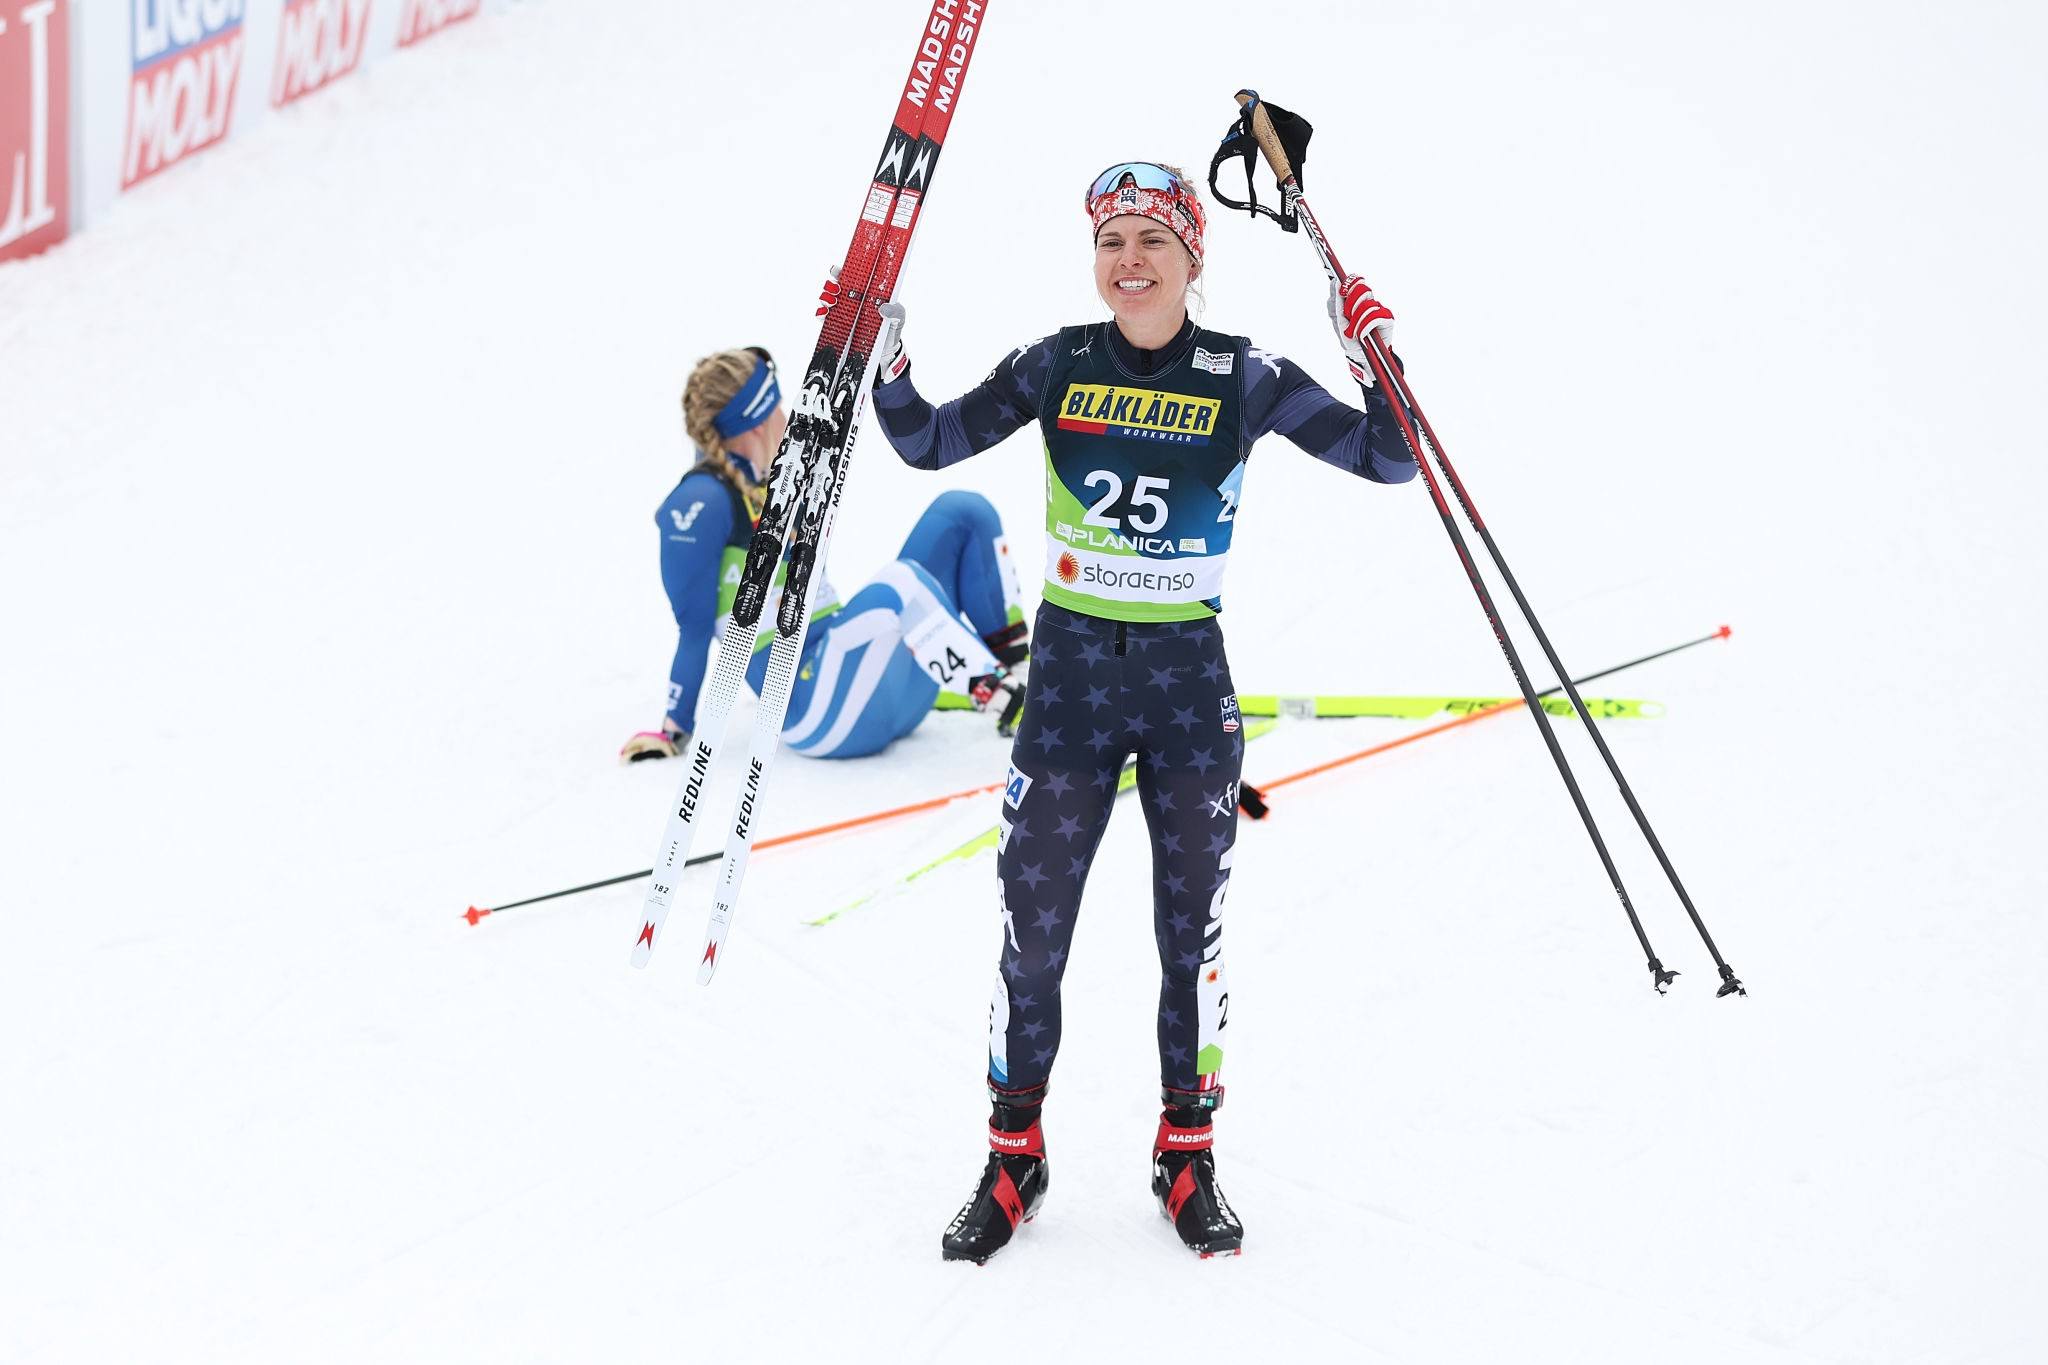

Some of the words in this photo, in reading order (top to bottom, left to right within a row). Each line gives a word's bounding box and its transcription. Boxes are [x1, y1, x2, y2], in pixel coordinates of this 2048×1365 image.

[906, 0, 959, 108] MADSH
[934, 0, 982, 113] MADSH
[126, 35, 243, 179] MOLY
[1197, 349, 1232, 361] PLANICA
[1065, 388, 1213, 432] BLÅKLÄDER
[1123, 428, 1192, 443] WORKWEAR
[832, 424, 859, 508] MADSHUS
[1081, 469, 1171, 534] 25
[1071, 528, 1176, 554] PLANICA
[929, 646, 967, 684] 24
[678, 741, 712, 823] REDLINE
[735, 756, 763, 840] REDLINE
[654, 883, 670, 894] 182
[716, 901, 729, 912] 182
